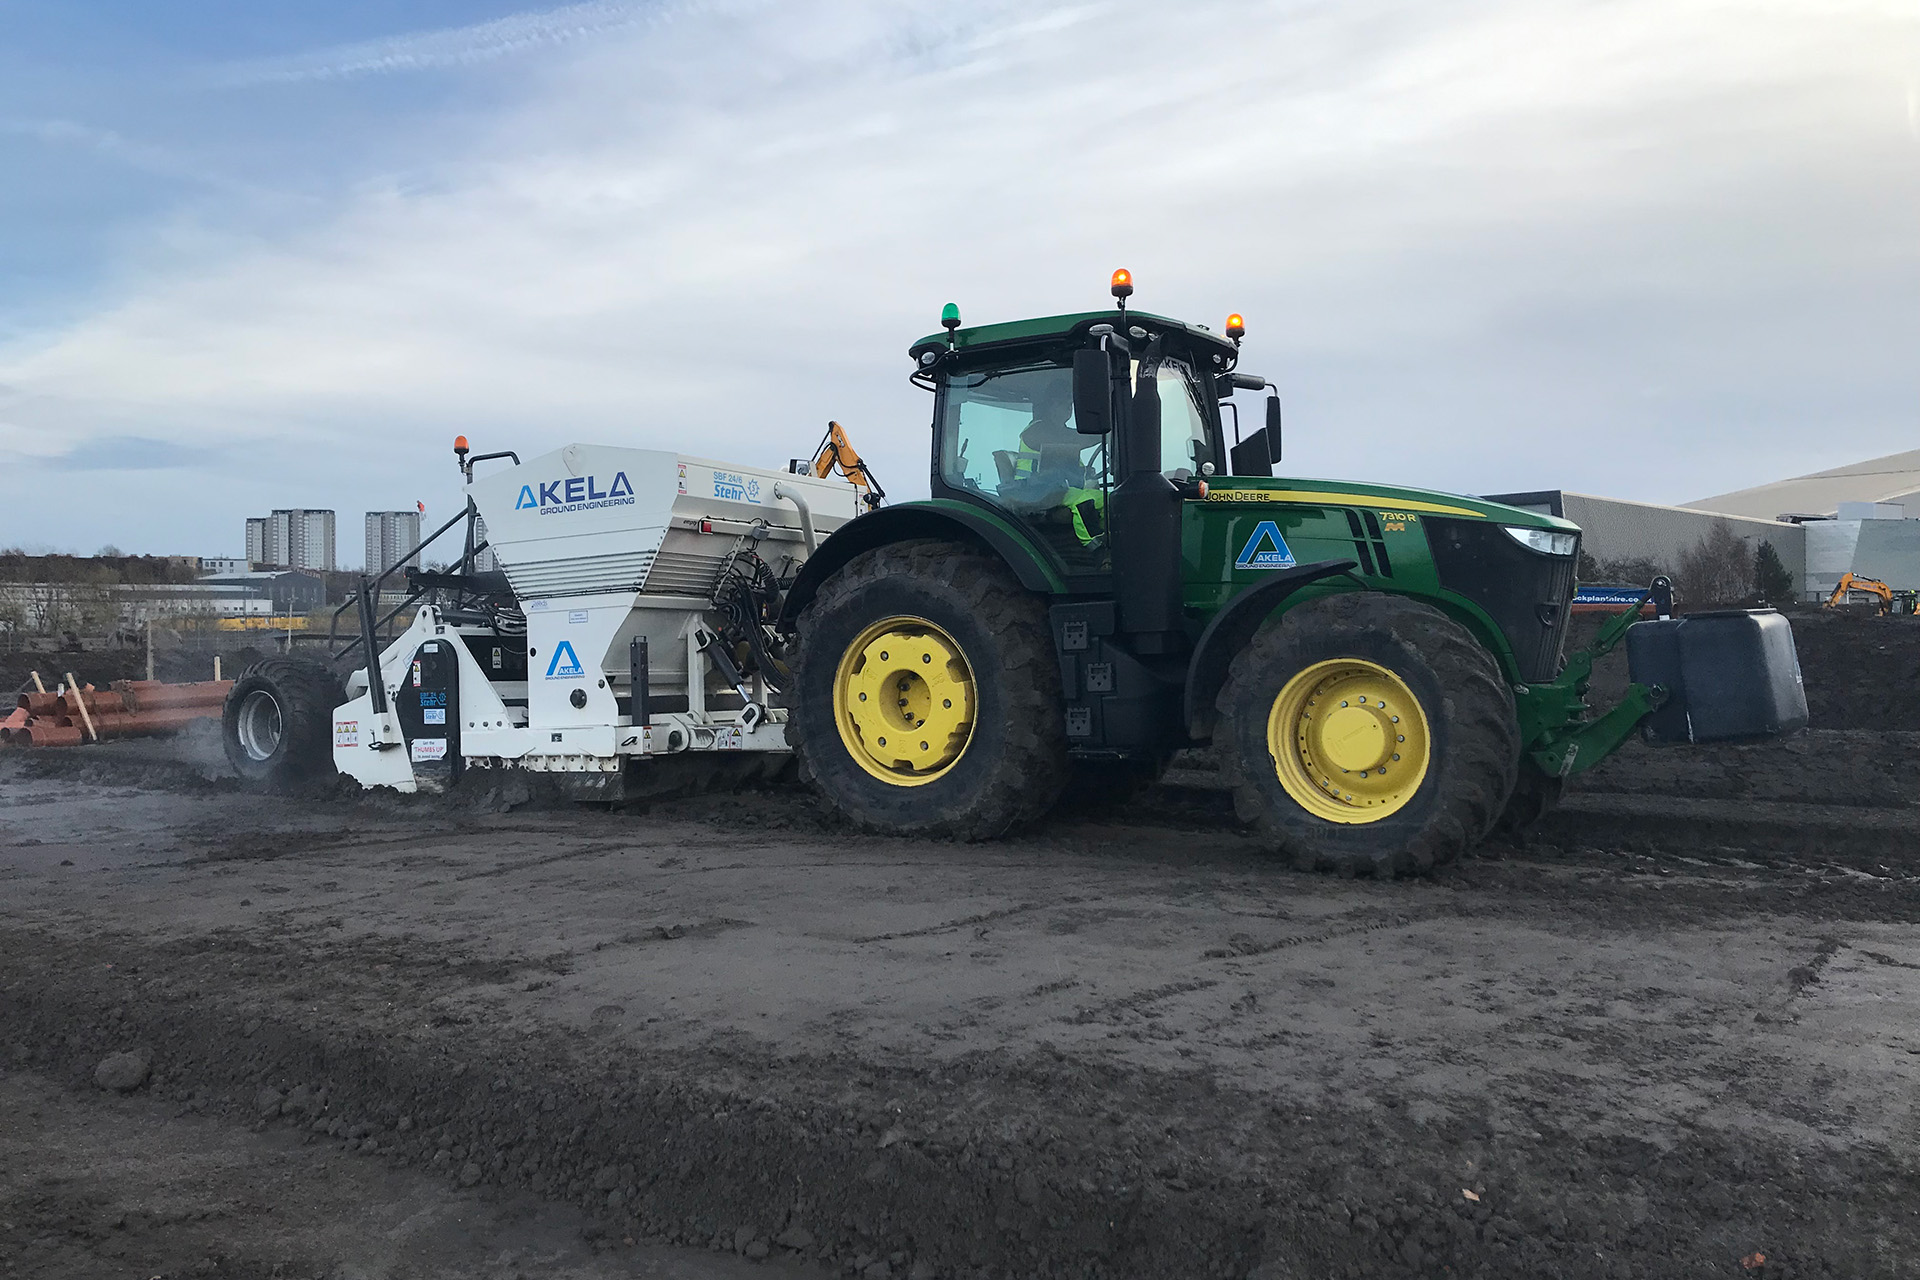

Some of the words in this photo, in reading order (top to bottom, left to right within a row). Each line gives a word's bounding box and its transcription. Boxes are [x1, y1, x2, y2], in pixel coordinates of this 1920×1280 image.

[713, 471, 727, 481] SBF
[728, 474, 743, 484] 24/6
[515, 471, 634, 510] AKELA
[713, 484, 744, 501] Stehr
[1235, 491, 1270, 501] DEERE
[540, 505, 577, 516] GROUND
[577, 496, 635, 511] ENGINEERING
[1256, 554, 1292, 562] AKELA
